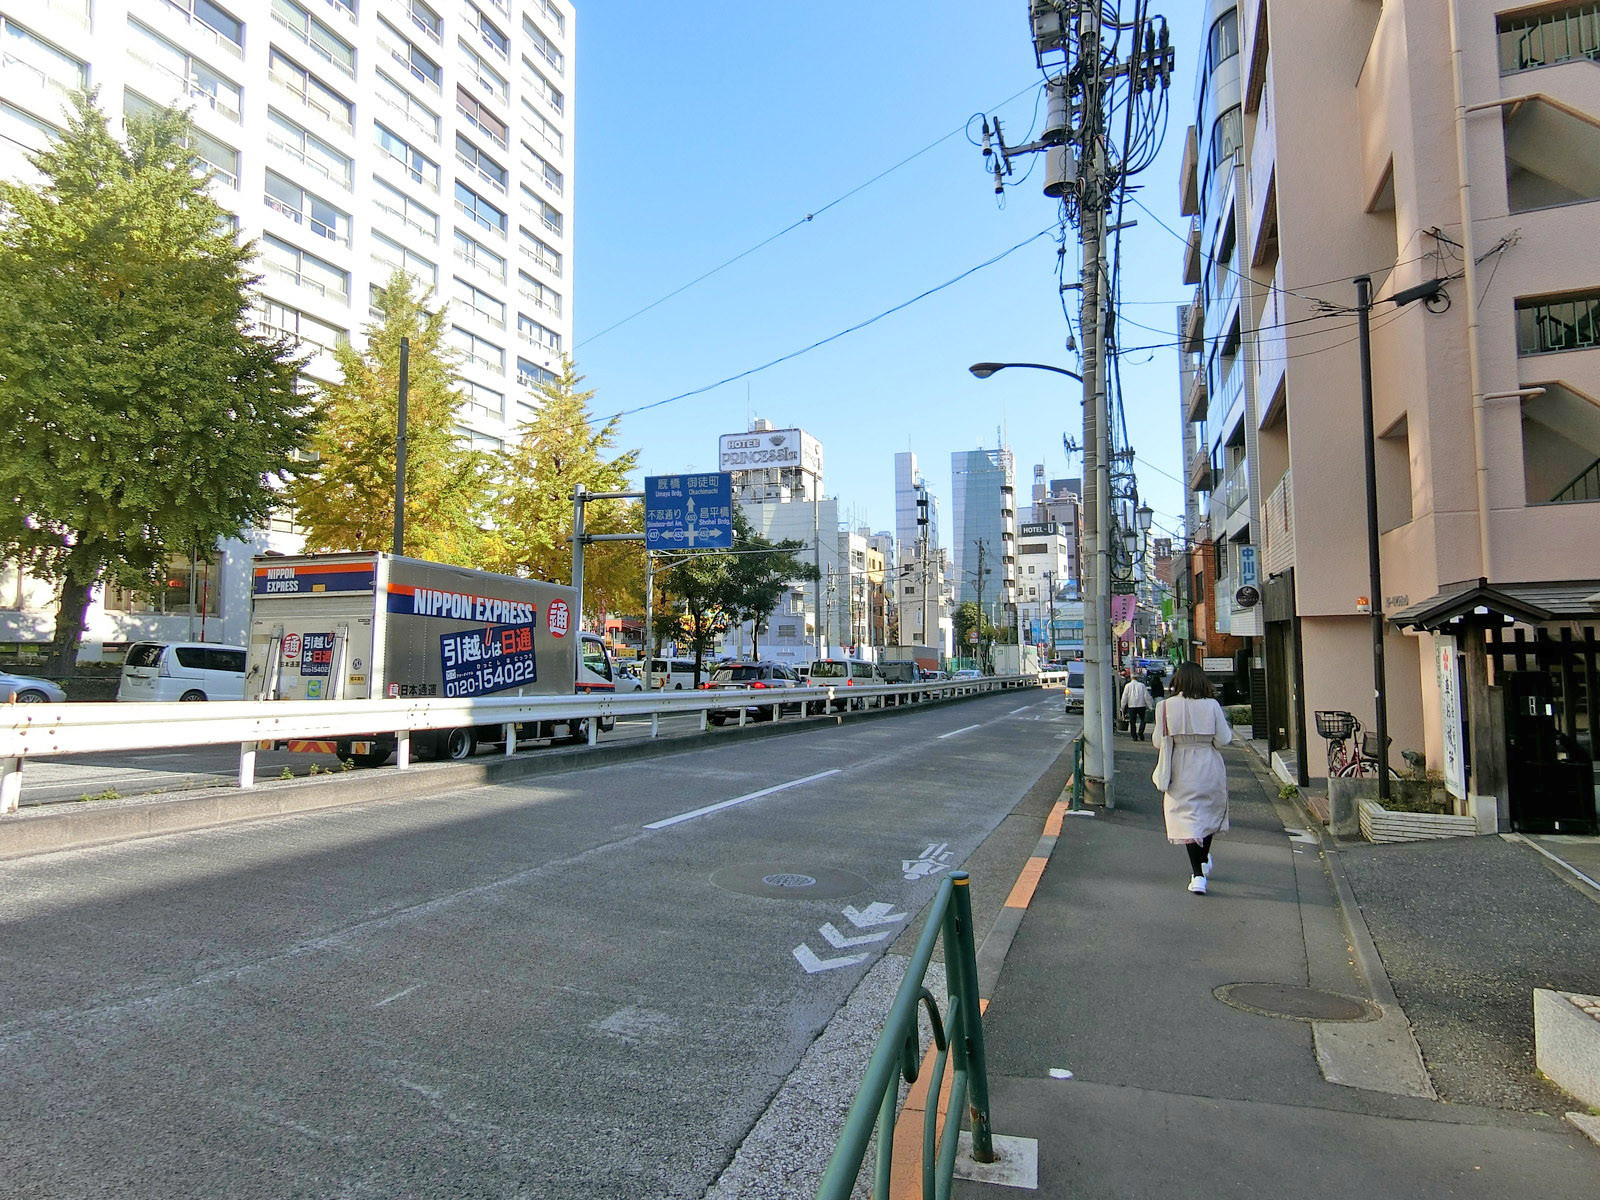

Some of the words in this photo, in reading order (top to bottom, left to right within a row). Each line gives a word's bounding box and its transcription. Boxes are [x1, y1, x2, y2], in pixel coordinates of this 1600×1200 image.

[728, 440, 760, 449] HOTEL
[687, 476, 719, 488] 御徒町
[647, 509, 682, 520] 不忍通り
[700, 507, 730, 519] 昌平橋
[1241, 547, 1255, 585] 中川ビ
[267, 568, 296, 580] NIPPON
[266, 581, 299, 593] EXPRESS
[413, 588, 473, 620] NIPPON
[475, 597, 533, 625] EXPRESS
[550, 602, 569, 636] 通
[284, 635, 300, 656] 通
[304, 636, 333, 649] 引越し
[443, 627, 532, 667] 引越しは日通
[446, 660, 534, 698] 0120-154022
[401, 684, 437, 696] 日本通運
